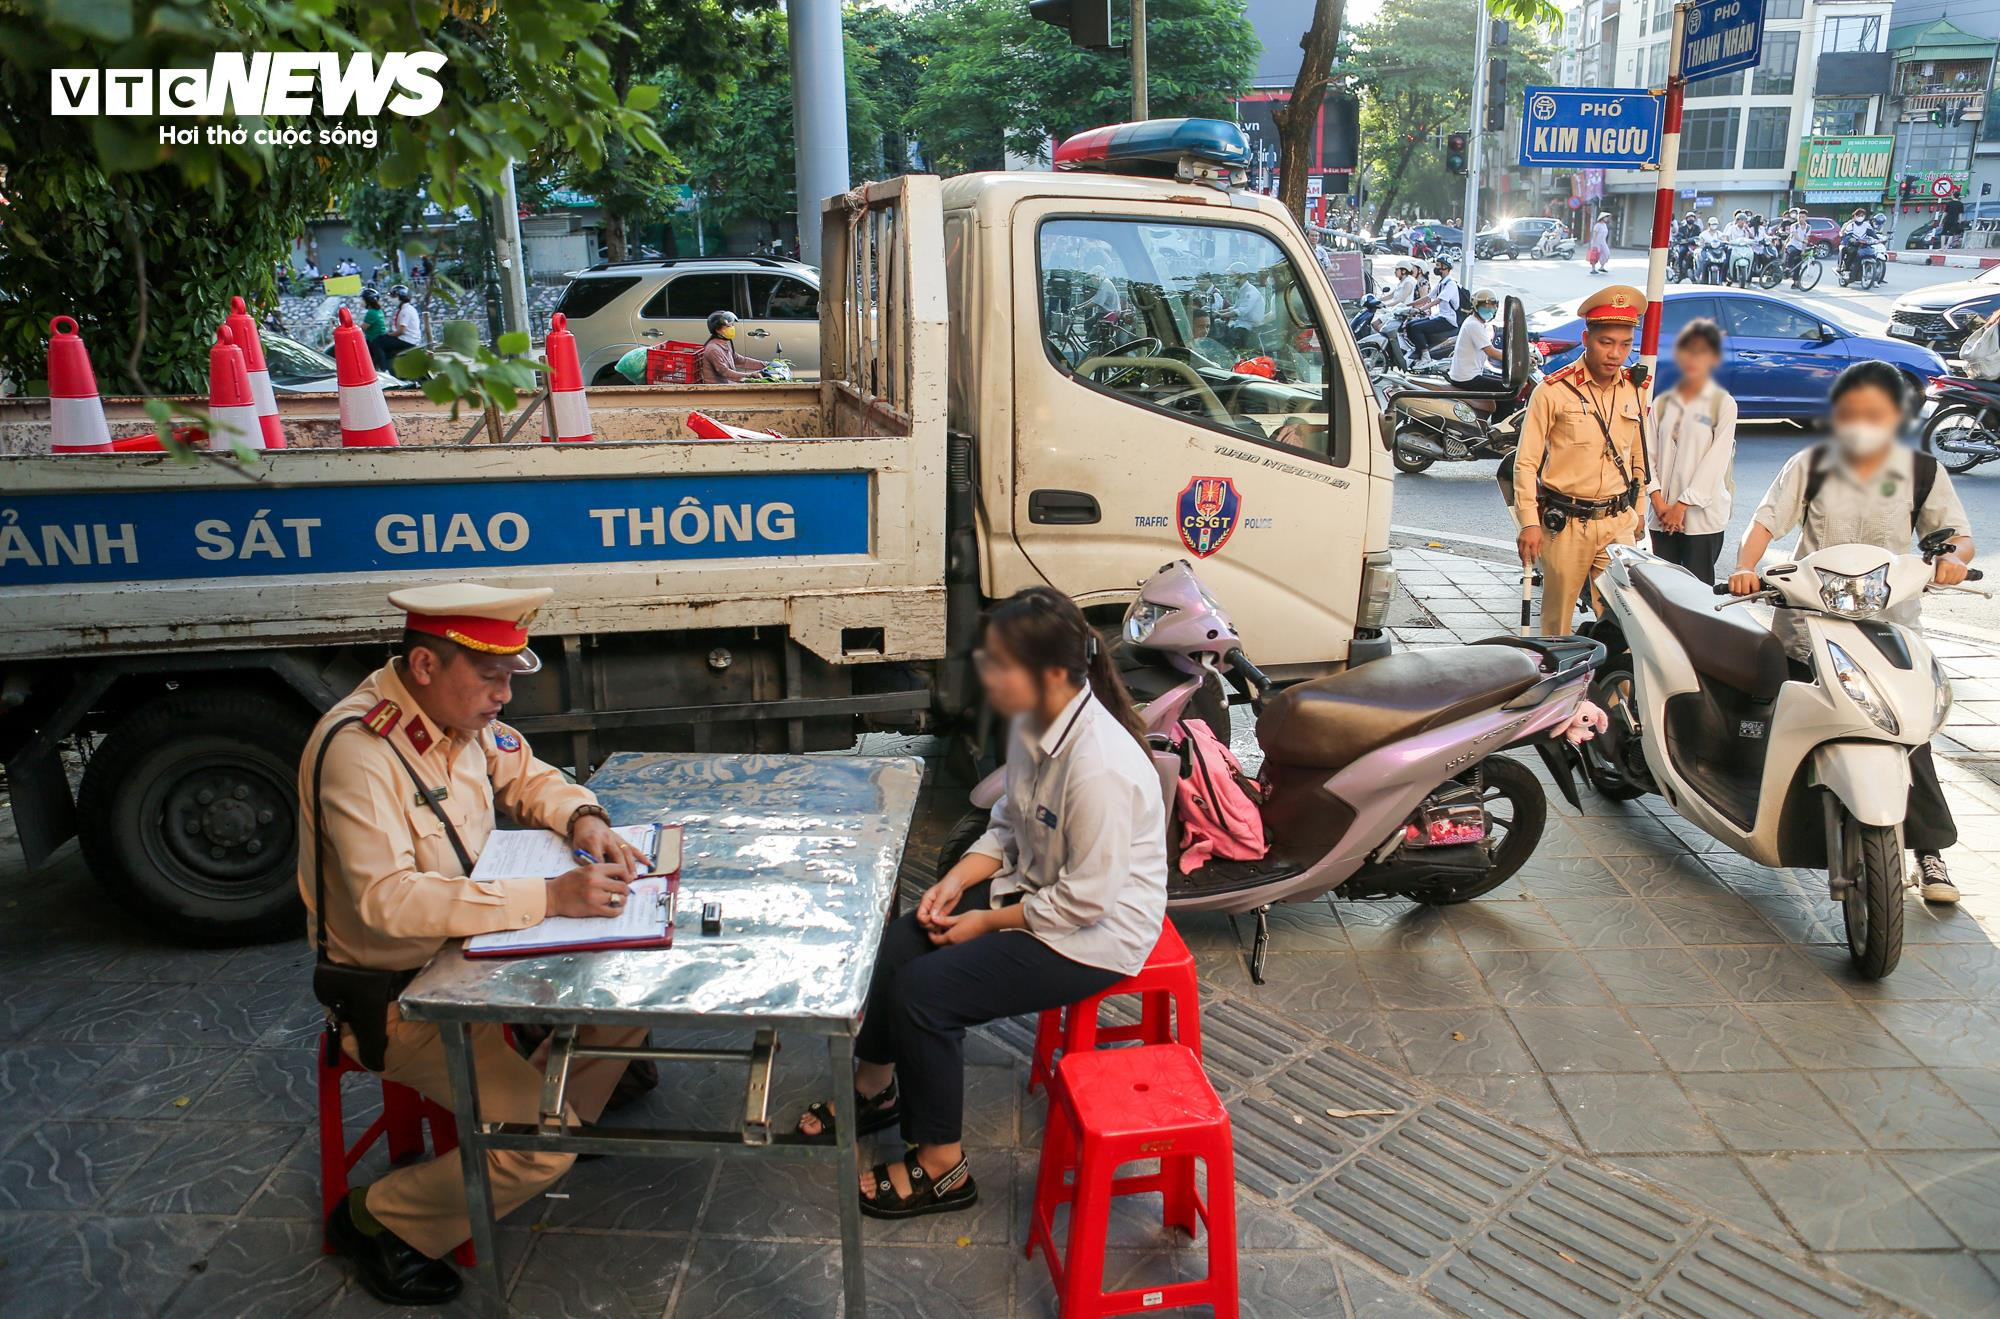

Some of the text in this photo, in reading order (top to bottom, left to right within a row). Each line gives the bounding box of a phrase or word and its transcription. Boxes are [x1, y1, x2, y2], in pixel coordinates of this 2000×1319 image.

[1686, 33, 1721, 68] THANH
[1580, 98, 1625, 117] PHỐ
[1534, 126, 1649, 155] KIM NGƯU
[1809, 144, 1835, 178] CẮT
[1835, 148, 1859, 178] TÓC
[1857, 152, 1889, 178] NAM
[1214, 446, 1351, 489] TURBO INTERCOOLER
[194, 509, 321, 561] SÁT
[375, 512, 530, 554] GIAO
[589, 496, 796, 547] THÔNG
[1135, 516, 1168, 527] TRAFFIC
